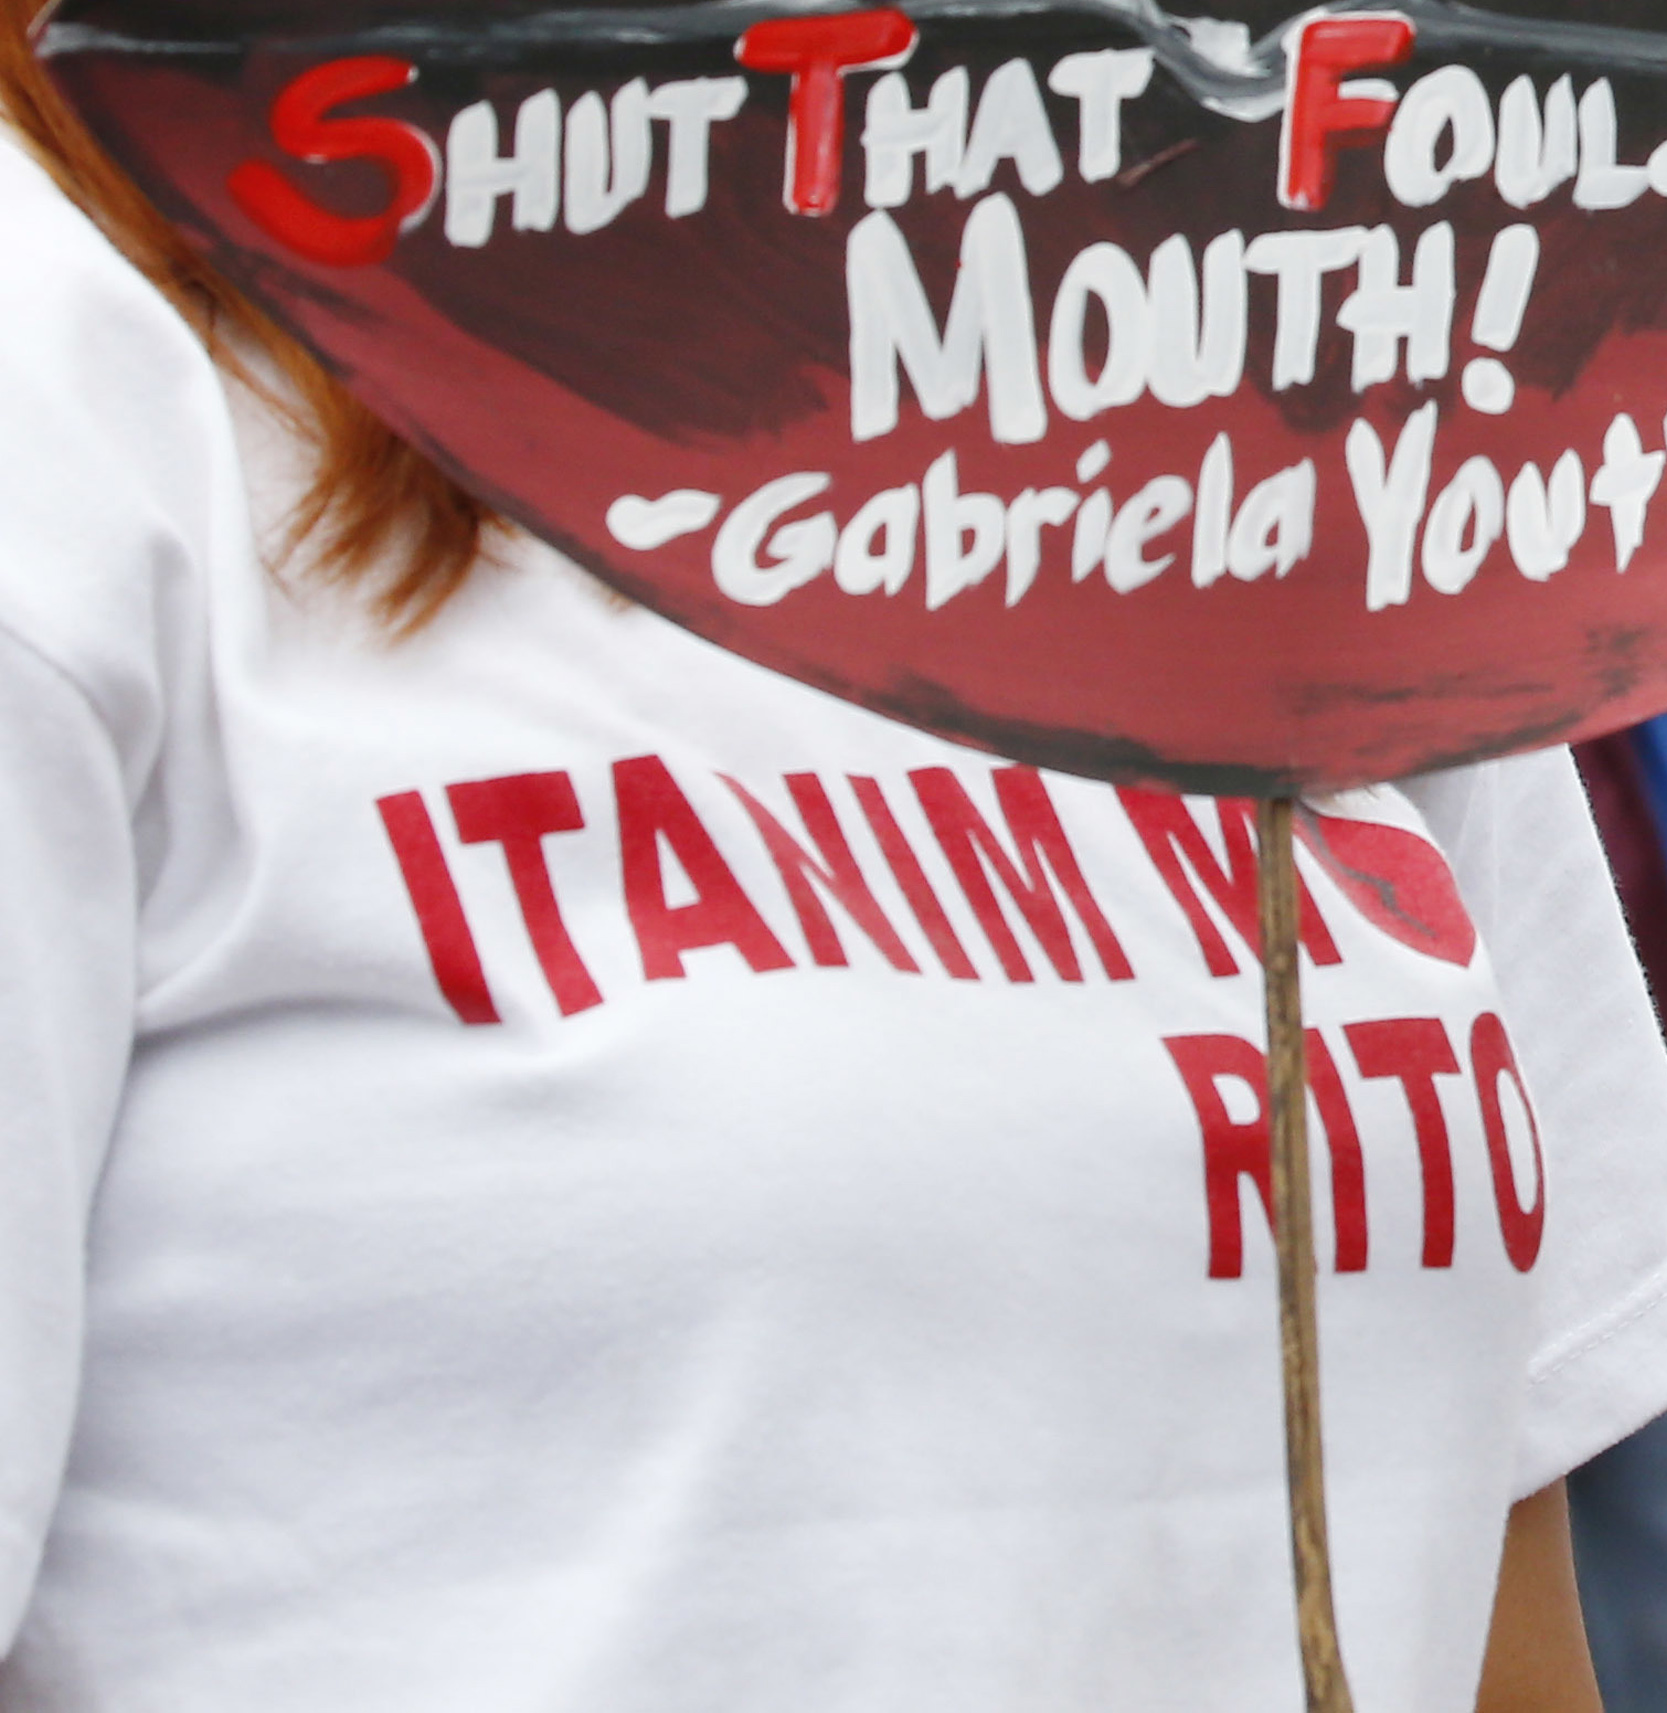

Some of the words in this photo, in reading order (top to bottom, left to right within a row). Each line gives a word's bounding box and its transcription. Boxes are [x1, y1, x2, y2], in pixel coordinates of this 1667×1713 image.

[226, 56, 750, 268] SHUT
[735, 7, 1156, 216] THAT
[845, 192, 1540, 445] MOUTH!
[375, 753, 1137, 1026] ITANIM
[1161, 1010, 1546, 1280] RITO
